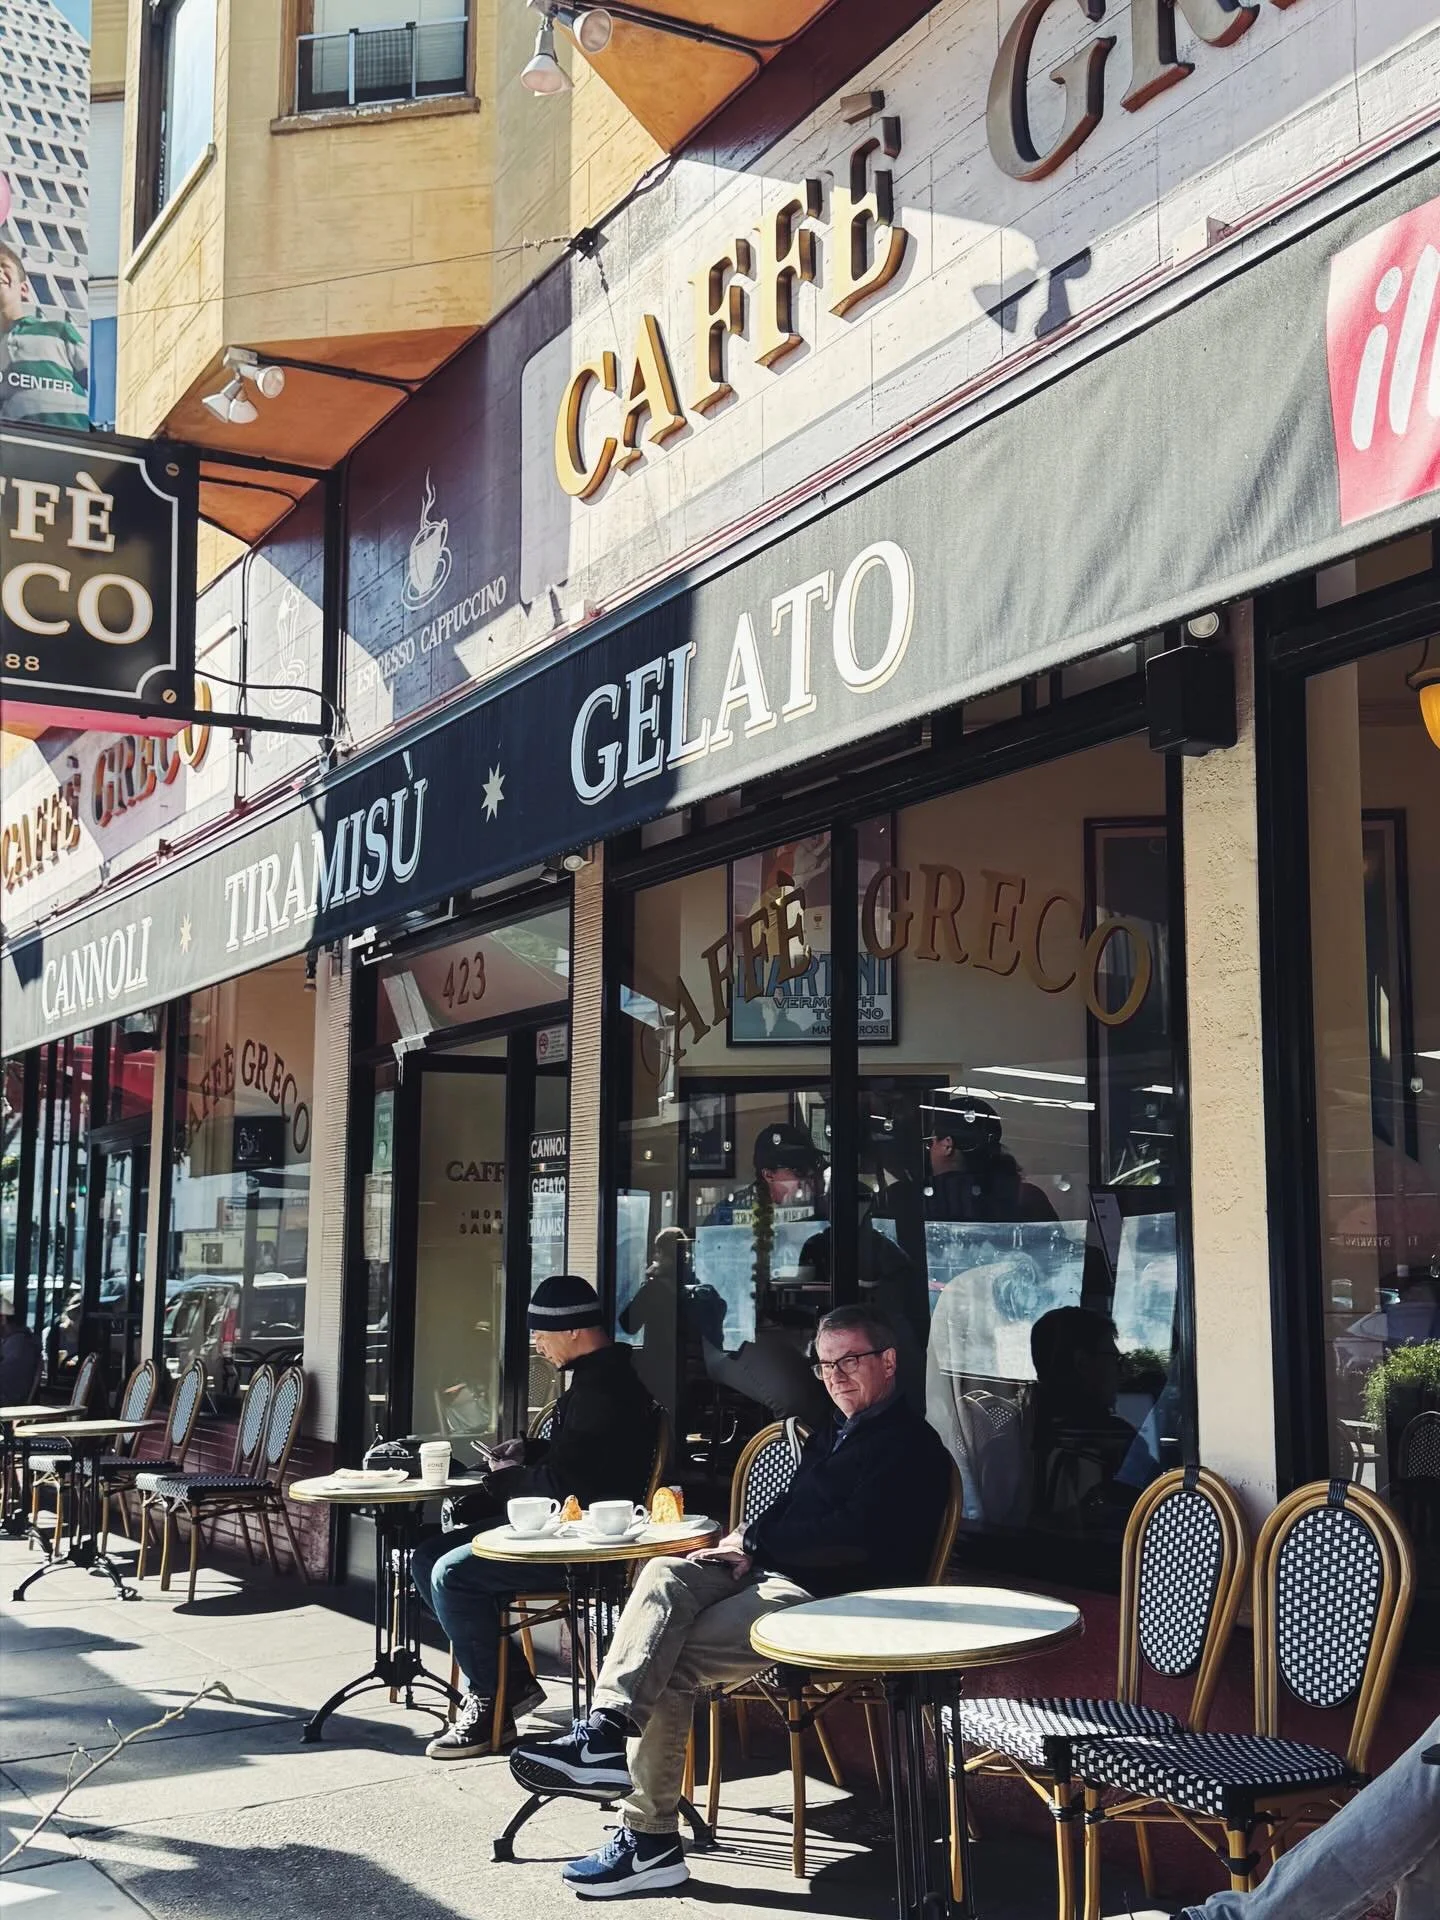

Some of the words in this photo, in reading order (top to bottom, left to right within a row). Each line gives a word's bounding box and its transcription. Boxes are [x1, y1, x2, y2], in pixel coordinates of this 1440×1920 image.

[554, 90, 909, 499] CAFFÈ
[1351, 243, 1440, 452] il
[7, 372, 74, 393] CENTER
[0, 471, 116, 553] FÈ
[2, 562, 154, 645] CO
[356, 637, 416, 695] ESPRESSO
[420, 575, 508, 653] CAPPUCCINO
[5, 653, 40, 672] 88
[41, 915, 153, 1025] CANNOLI
[223, 751, 429, 953] TIRAMISÙ
[570, 540, 915, 806] GELATO
[442, 951, 486, 1009] 423
[861, 863, 1152, 1028] GRECO
[241, 1038, 310, 1154] GRECO
